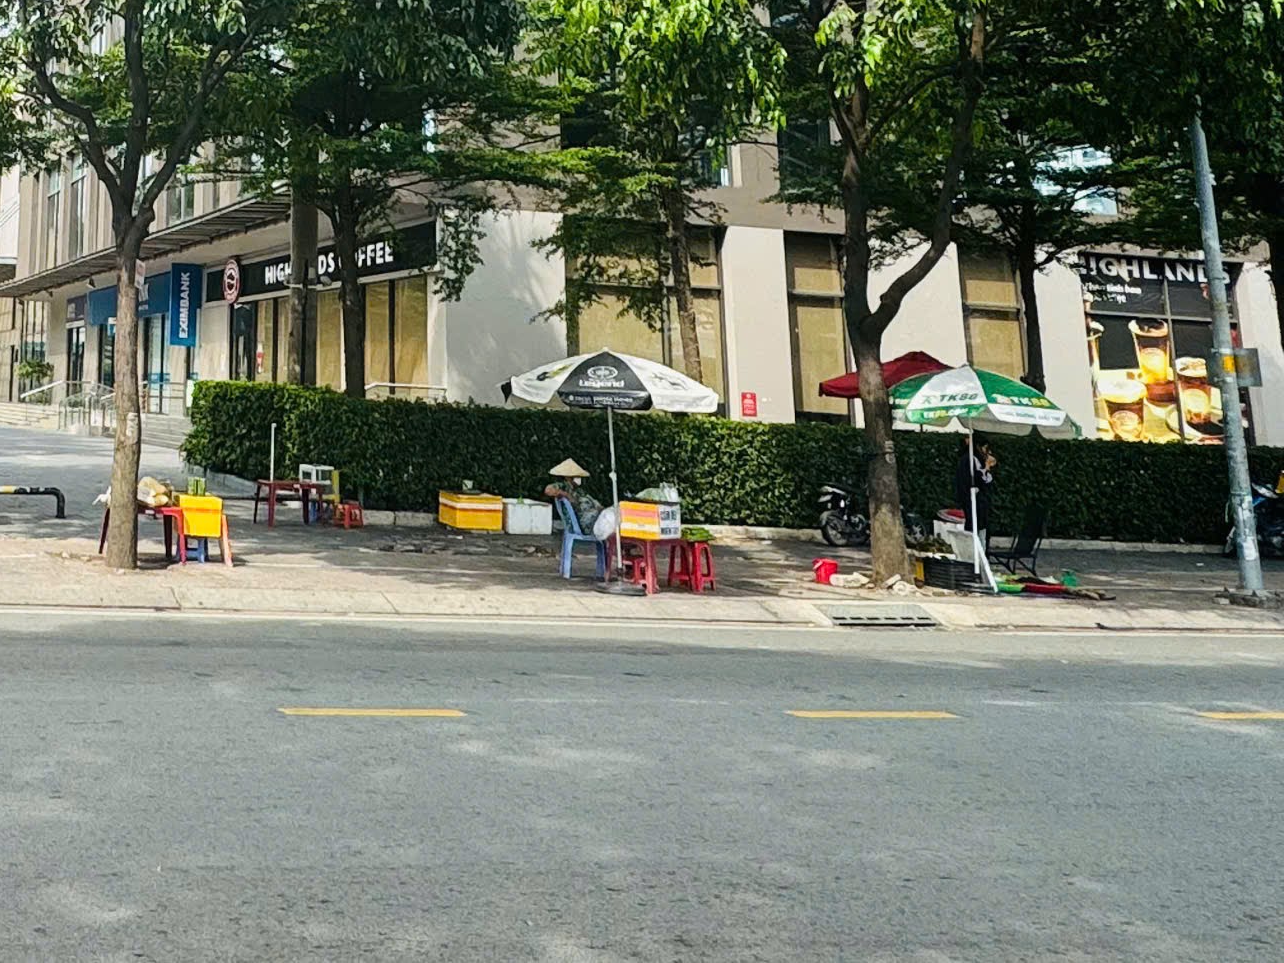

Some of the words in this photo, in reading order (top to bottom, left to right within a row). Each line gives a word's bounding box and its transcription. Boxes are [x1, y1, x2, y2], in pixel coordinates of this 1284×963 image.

[264, 252, 335, 286] HIGHDS
[338, 241, 394, 270] FFEE
[178, 272, 191, 339] EXIMBANK
